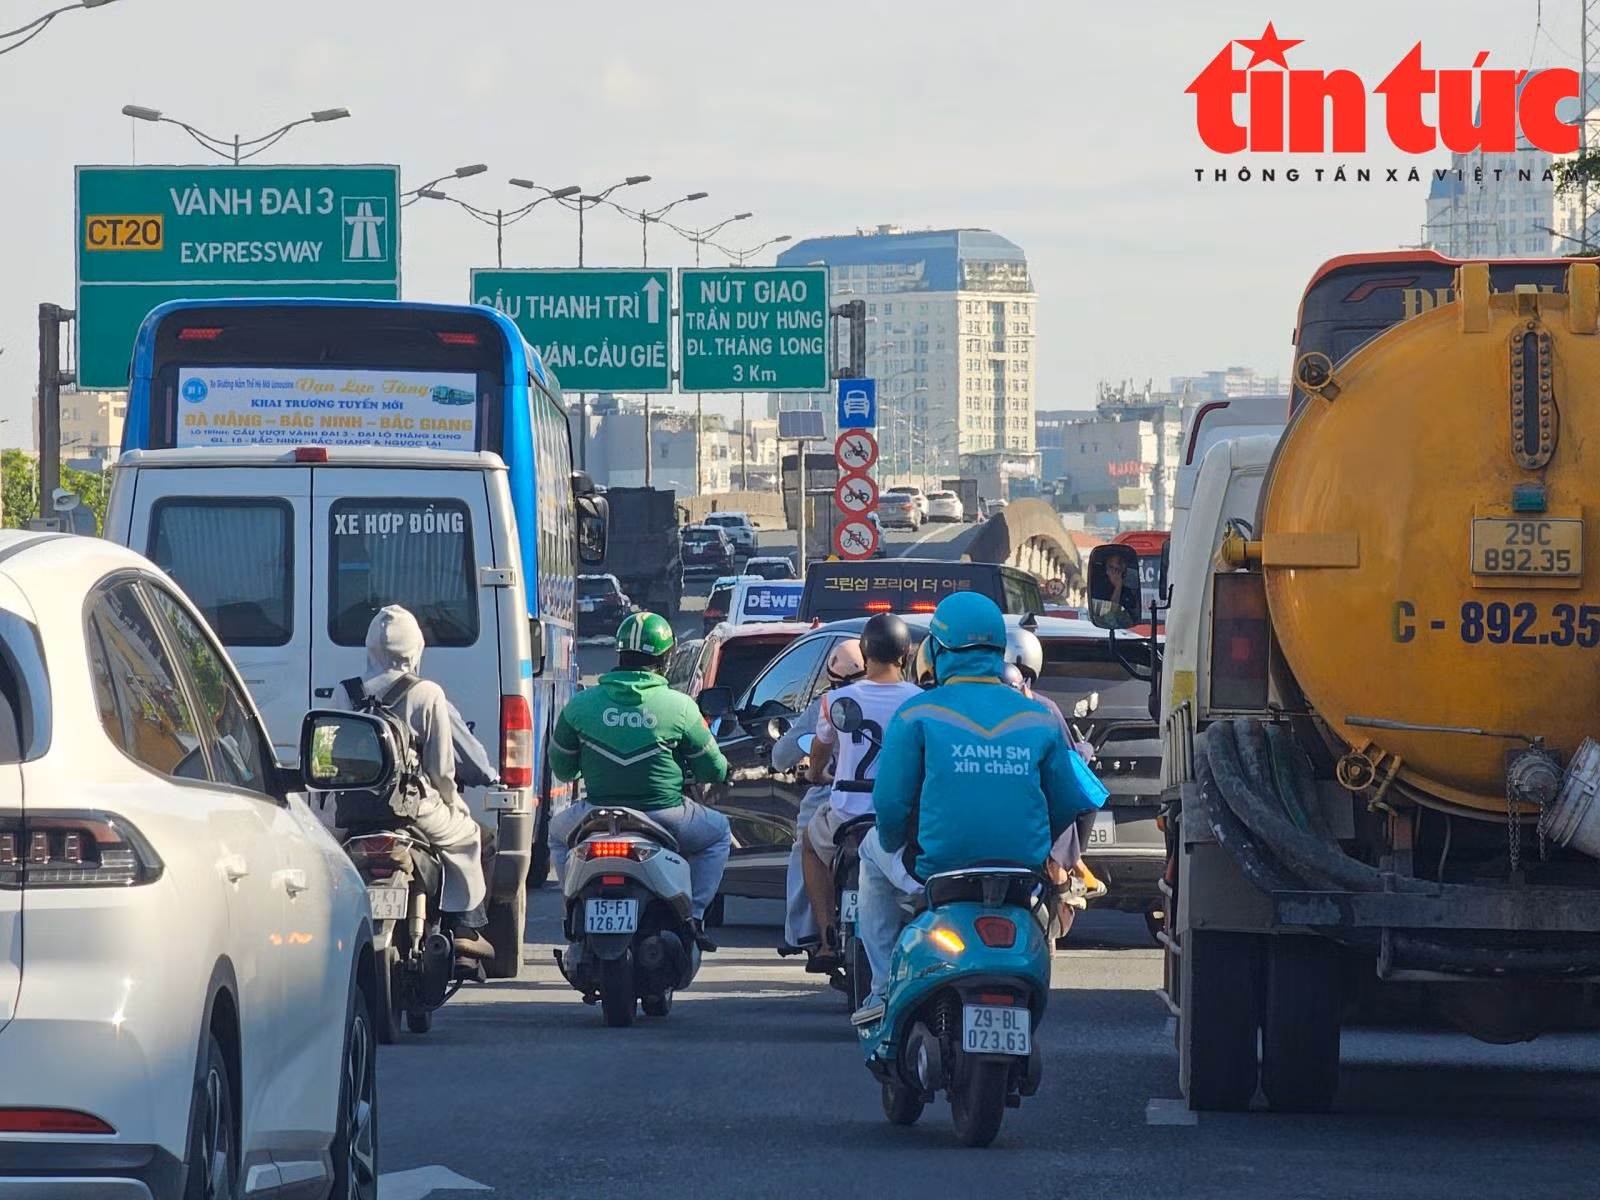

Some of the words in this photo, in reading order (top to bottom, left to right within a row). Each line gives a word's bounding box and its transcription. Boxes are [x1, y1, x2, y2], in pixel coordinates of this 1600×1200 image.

[170, 183, 252, 215] VÀNH
[260, 187, 311, 215] ĐAI
[317, 187, 335, 215] 3
[88, 219, 161, 246] CT.20
[181, 242, 323, 264] EXPRESSWAY
[701, 275, 746, 304] NÚT
[754, 280, 807, 303] GIAO
[525, 296, 599, 319] THANH
[604, 291, 639, 319] TRÌ
[686, 306, 730, 330] TRẦN
[736, 311, 769, 329] DUY
[777, 309, 823, 329] HƯNG
[630, 341, 666, 367] GIẼ
[687, 338, 712, 355] ĐL.
[715, 335, 772, 355] THĂNG
[780, 337, 823, 355] LONG
[733, 364, 743, 381] 3
[749, 364, 777, 381] Km
[251, 399, 281, 408] KHAI
[285, 398, 334, 409] TRƯƠNG
[338, 398, 378, 409] TUYẾN
[320, 415, 362, 428] NINH
[420, 418, 472, 431] GIANG
[335, 514, 359, 535] XE
[365, 512, 404, 539] HỢP
[409, 504, 464, 534] ĐỒNG
[1506, 523, 1551, 545] 29C
[1484, 549, 1571, 572] 892.35
[824, 577, 869, 591] 그린섬
[873, 577, 918, 593] 프리어
[922, 578, 938, 593] 더
[748, 593, 801, 608] DEWE
[1461, 601, 1600, 647] 892.35
[603, 707, 657, 728] Grab
[951, 744, 1002, 758] XANH
[1006, 746, 1031, 760] SM
[954, 759, 980, 773] xin
[984, 760, 1029, 775] chào!
[595, 901, 629, 915] 15-F1
[590, 917, 633, 931] 126.74
[974, 1009, 1021, 1030] 29-BL
[968, 1030, 1026, 1051] 023.63
